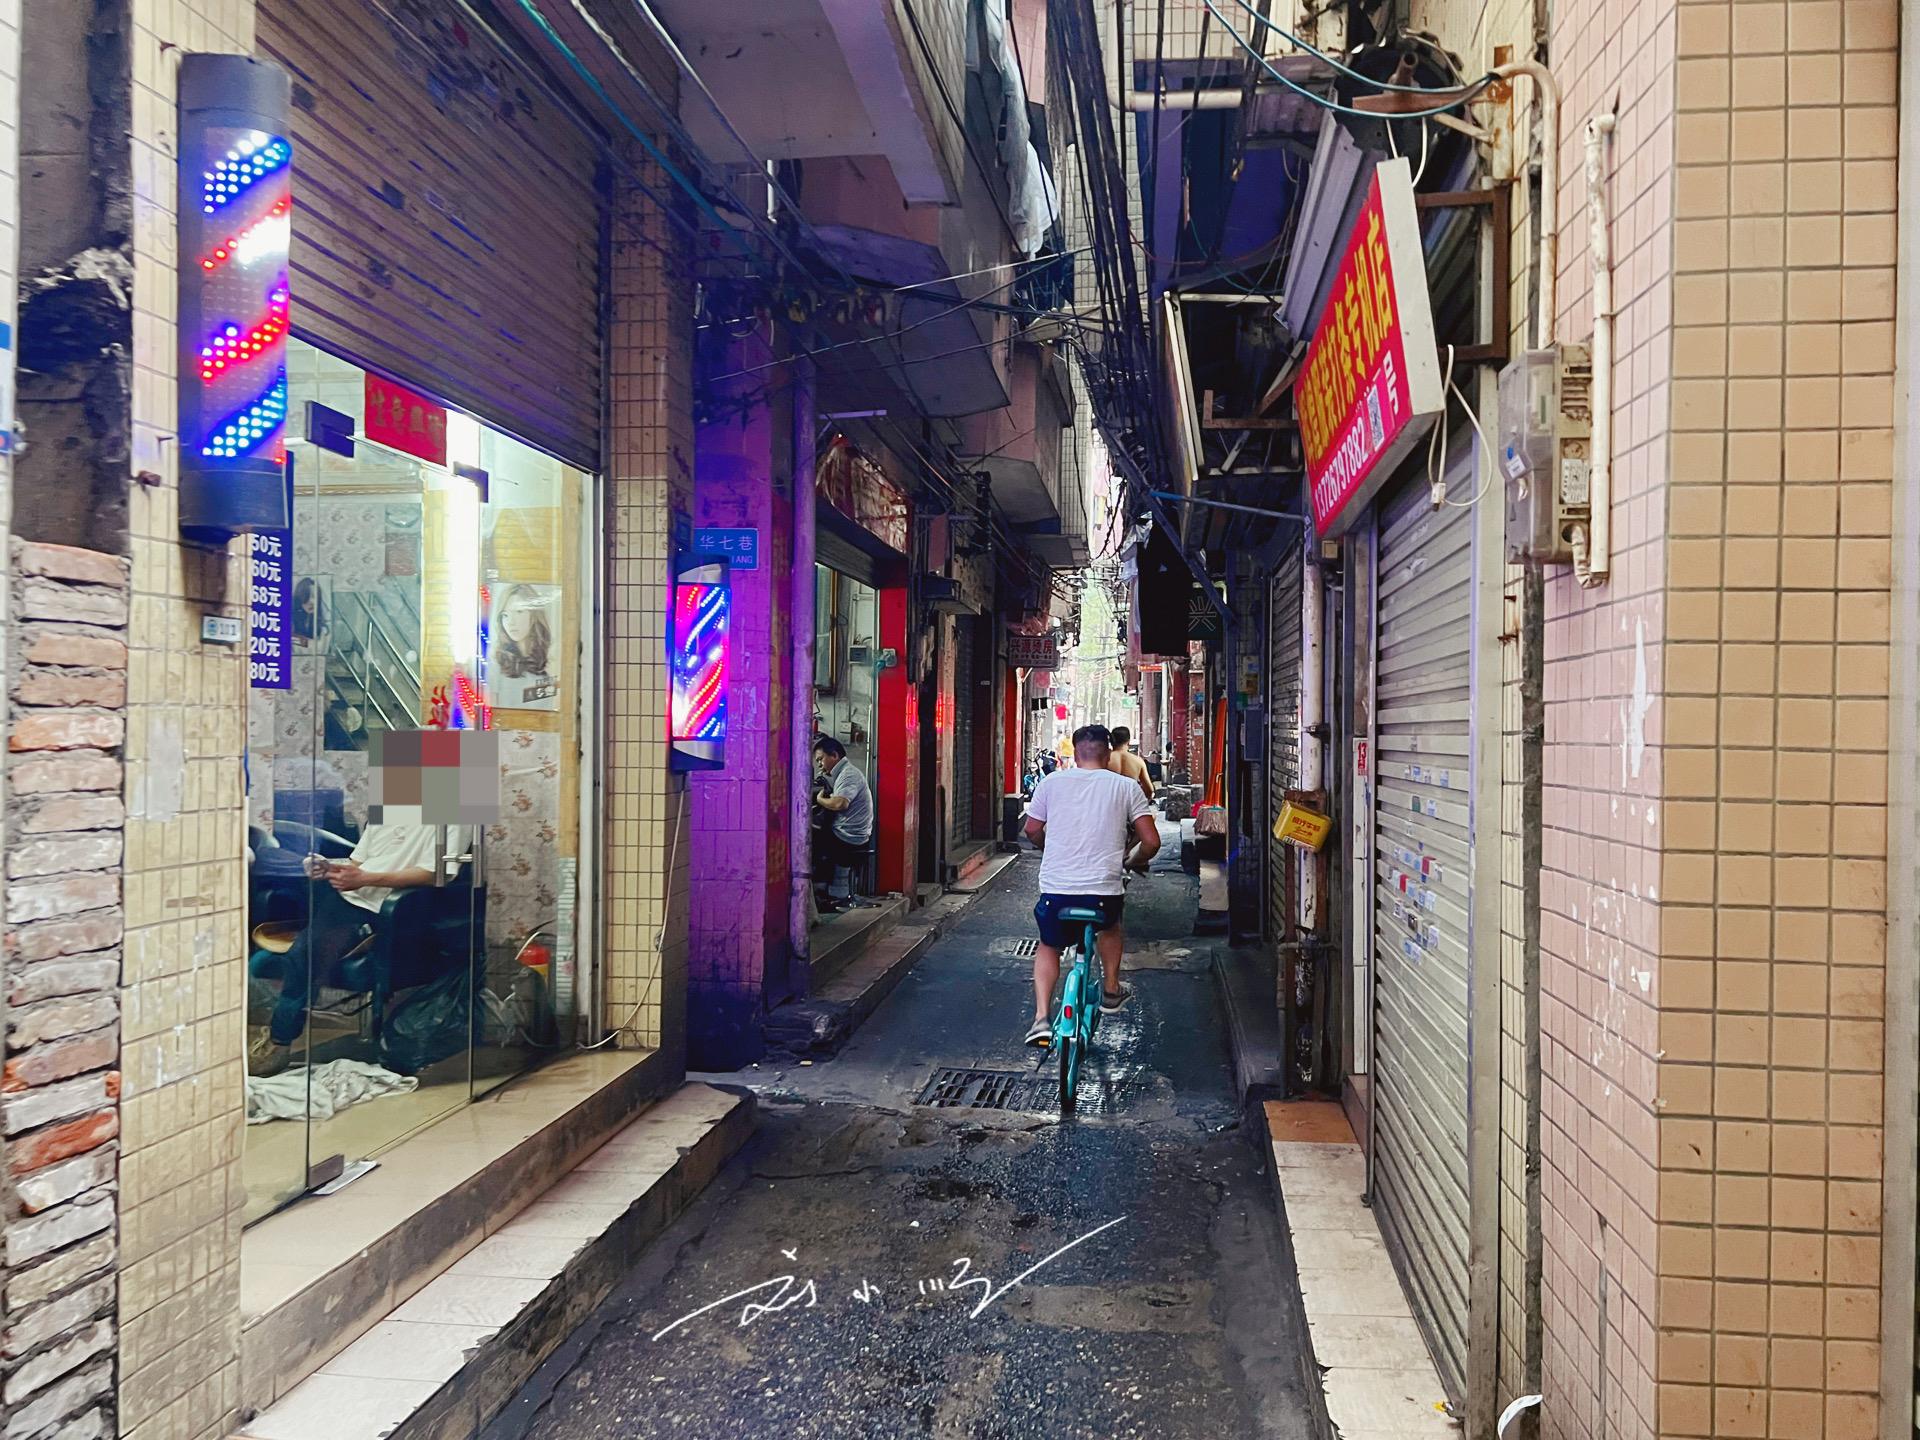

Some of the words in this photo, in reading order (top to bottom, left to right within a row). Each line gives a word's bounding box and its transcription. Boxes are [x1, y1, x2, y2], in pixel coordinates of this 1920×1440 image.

[1315, 416, 1367, 522] 13726797882
[698, 534, 753, 551] 华七巷
